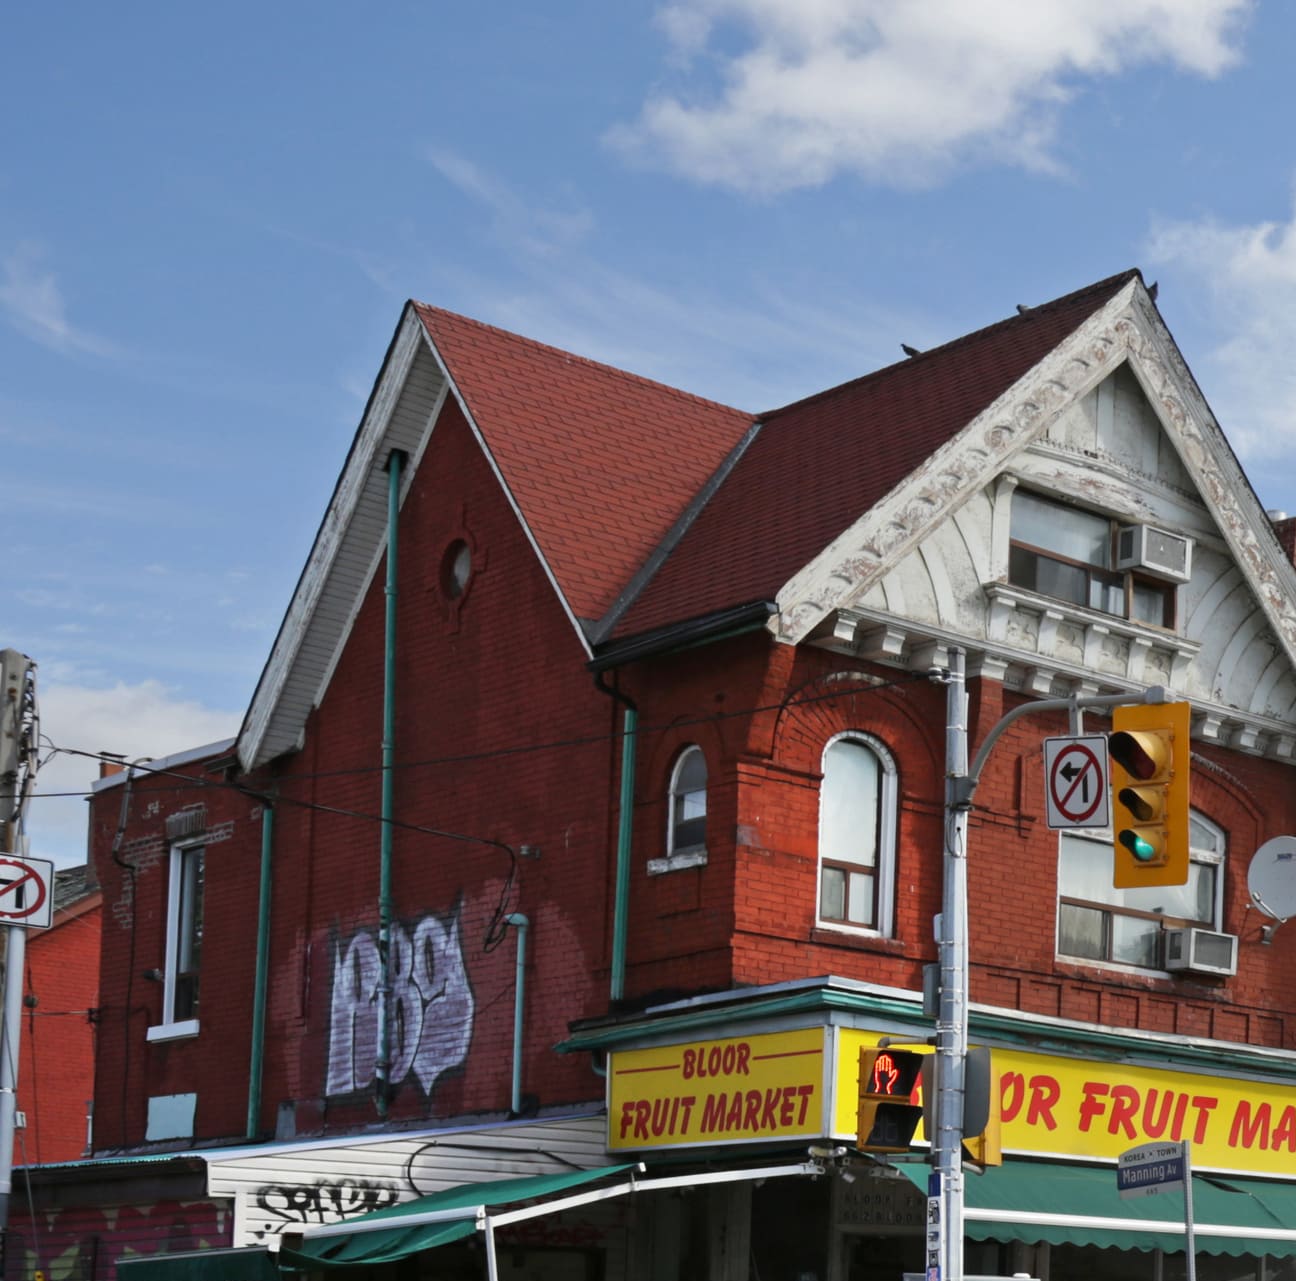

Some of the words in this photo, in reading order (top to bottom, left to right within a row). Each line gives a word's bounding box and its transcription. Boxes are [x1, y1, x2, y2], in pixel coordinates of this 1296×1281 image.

[682, 1042, 751, 1080] BLOOR
[619, 1094, 696, 1140] FRUIT
[700, 1084, 814, 1133] MARKET
[1078, 1081, 1218, 1145] FRUIT
[1124, 1153, 1145, 1163] KOREA
[1157, 1146, 1177, 1157] TOWN
[1123, 1165, 1165, 1184] Manning
[1166, 1164, 1177, 1176] Av
